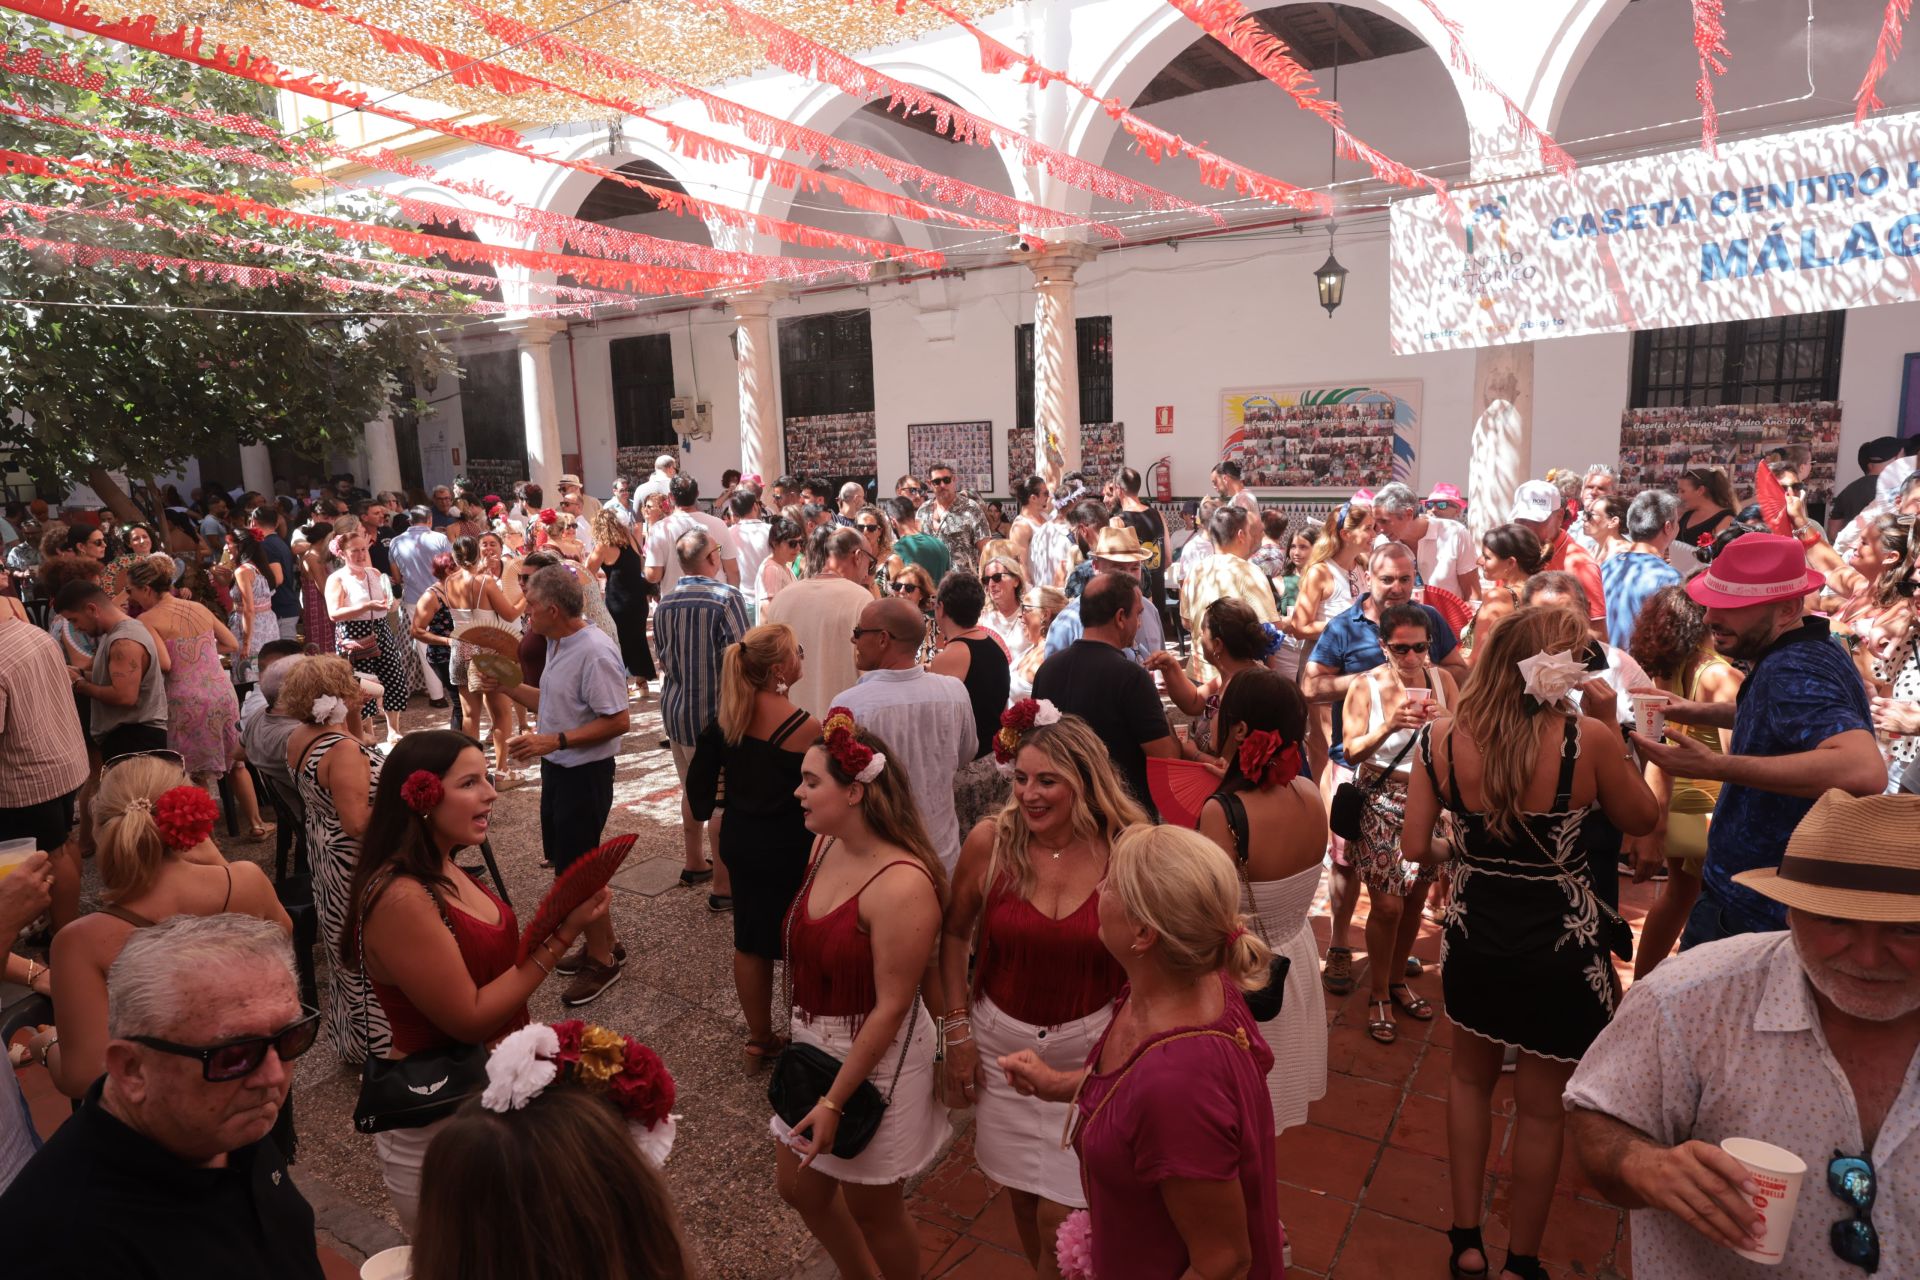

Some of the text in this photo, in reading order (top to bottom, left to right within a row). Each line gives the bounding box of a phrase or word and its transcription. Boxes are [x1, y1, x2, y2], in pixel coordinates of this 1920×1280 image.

[1551, 197, 1697, 240] CASETA
[1711, 166, 1889, 217] CENTRO
[1633, 422, 1664, 430] Caseta
[1683, 420, 1717, 431] Amigos
[1720, 417, 1731, 427] de
[1734, 418, 1760, 427] Pedro
[1785, 417, 1807, 425] 2017
